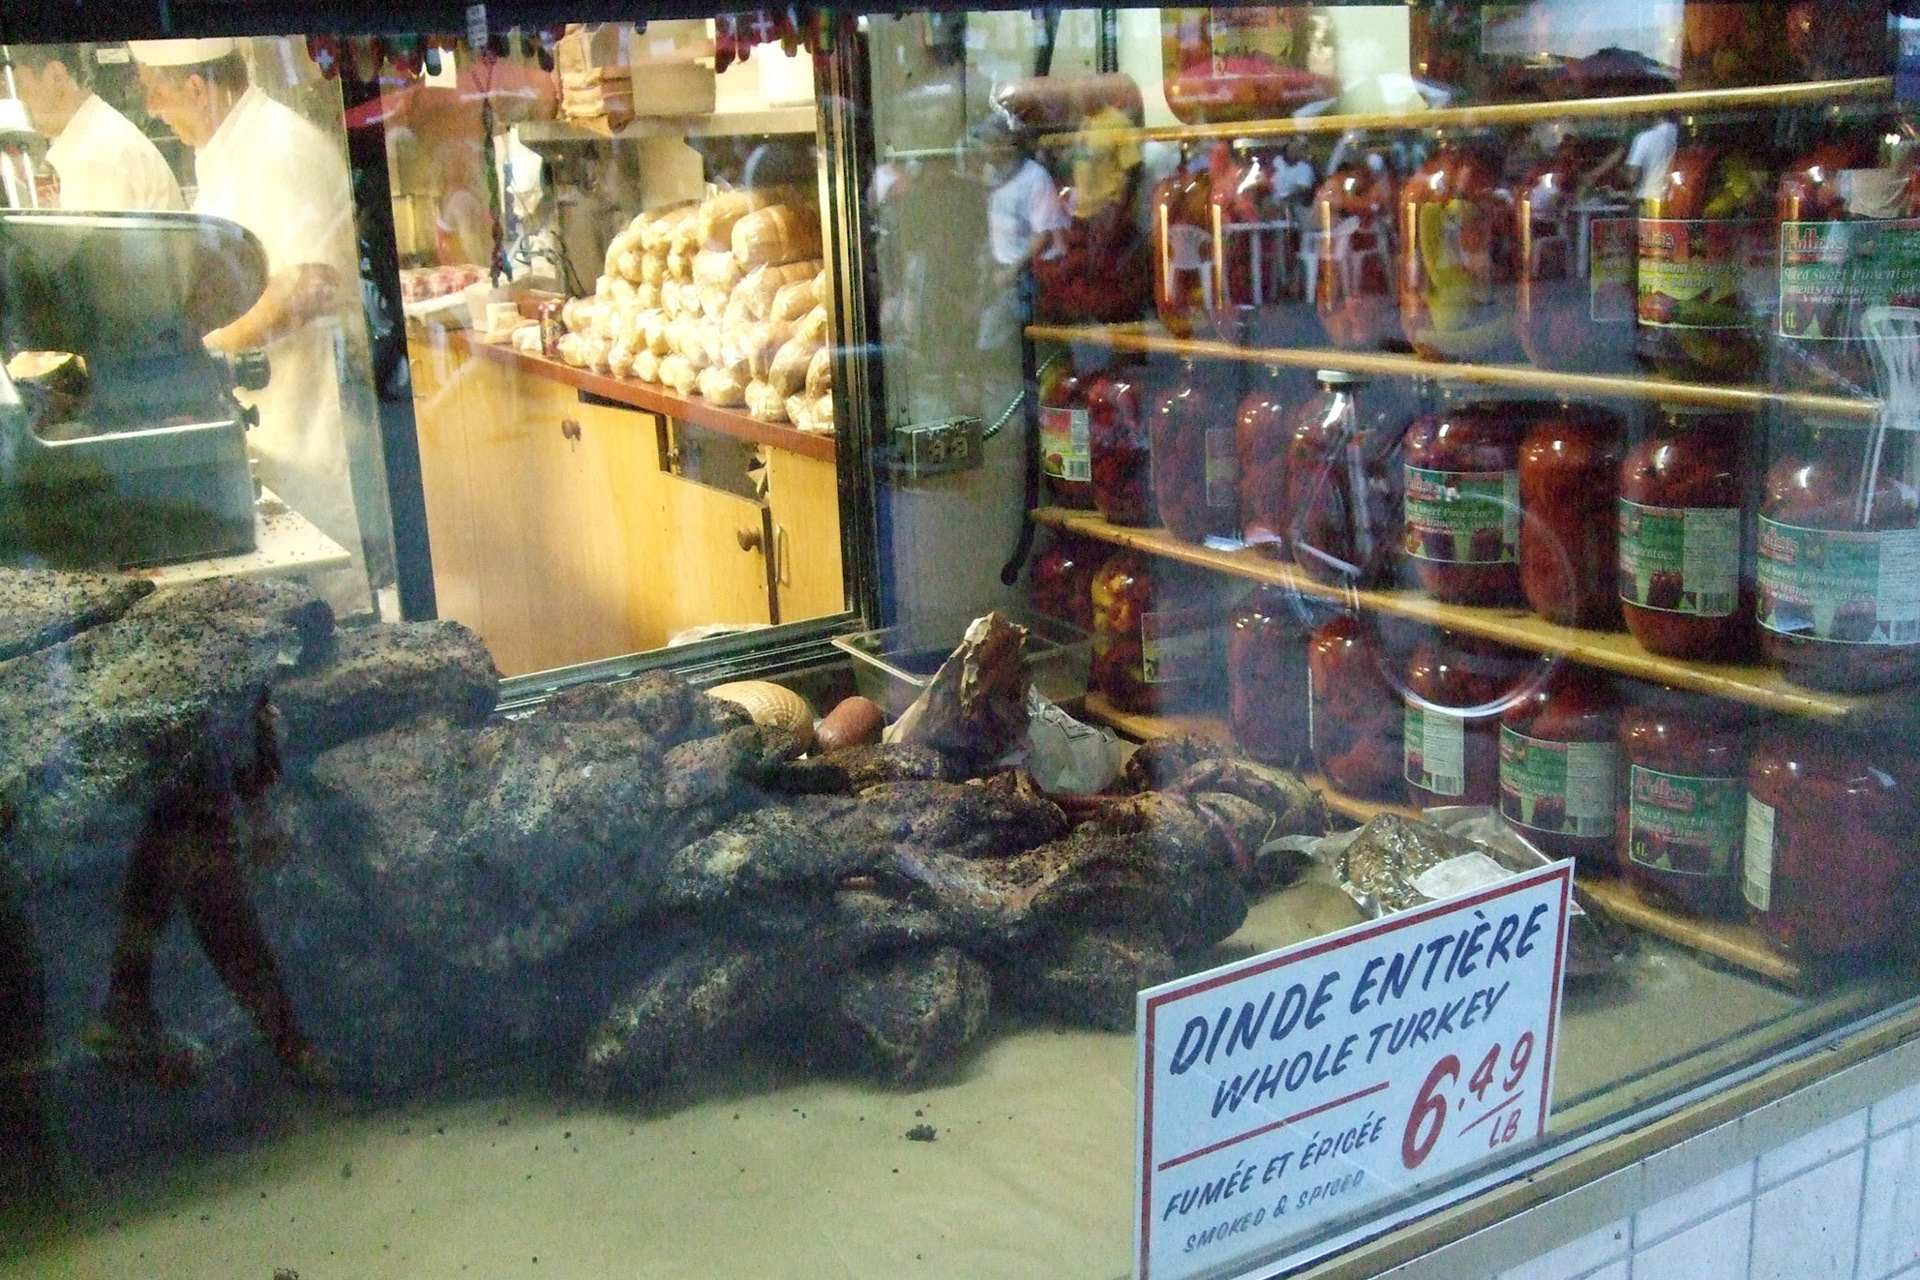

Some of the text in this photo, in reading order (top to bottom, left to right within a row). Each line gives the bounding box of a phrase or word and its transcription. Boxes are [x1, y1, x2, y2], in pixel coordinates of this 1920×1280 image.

[1812, 268, 1848, 281] Sweet
[1169, 902, 1549, 1076] DINDE ENTIÈRE
[1210, 980, 1511, 1119] WHOLE TURKEY
[1162, 1110, 1387, 1222] FUMÉE ET ÉPICÉE
[1488, 1108, 1522, 1149] LB
[1183, 1168, 1365, 1253] SMOKED & SPICED
